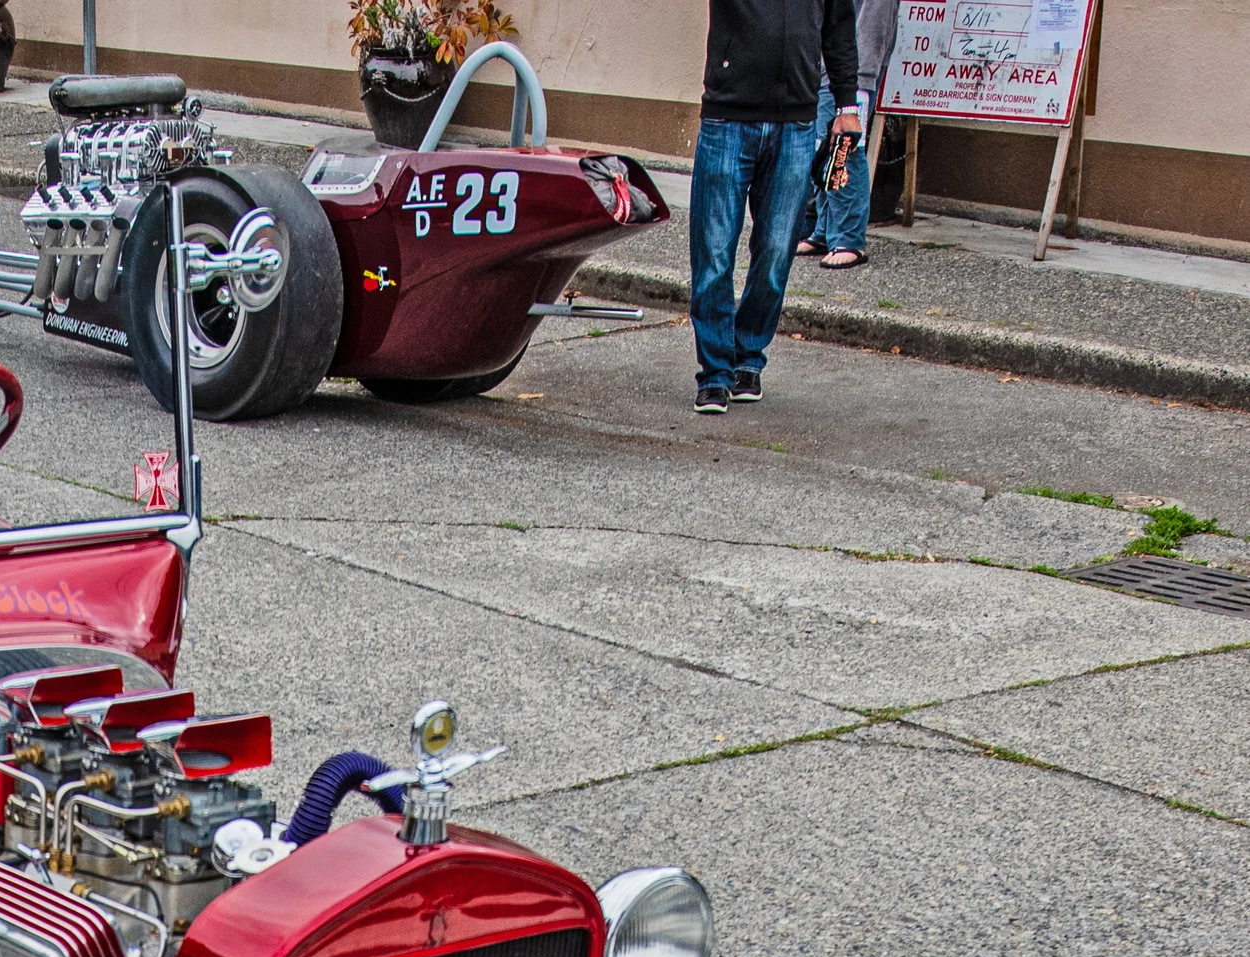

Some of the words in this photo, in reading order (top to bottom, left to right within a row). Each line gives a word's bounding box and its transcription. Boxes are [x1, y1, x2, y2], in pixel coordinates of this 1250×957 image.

[908, 6, 946, 22] FROM
[914, 36, 930, 51] TO
[901, 61, 937, 78] TOW
[945, 64, 1000, 81] AWAY
[1008, 69, 1058, 85] AREA
[955, 82, 986, 91] PROPERTY
[913, 89, 938, 98] AABCO
[938, 90, 978, 101] BARRICADE
[985, 93, 1002, 102] SIGN
[1003, 94, 1037, 104] COMPANY
[452, 171, 520, 235] 23
[415, 210, 431, 238] D
[45, 312, 80, 333] DONOVAN
